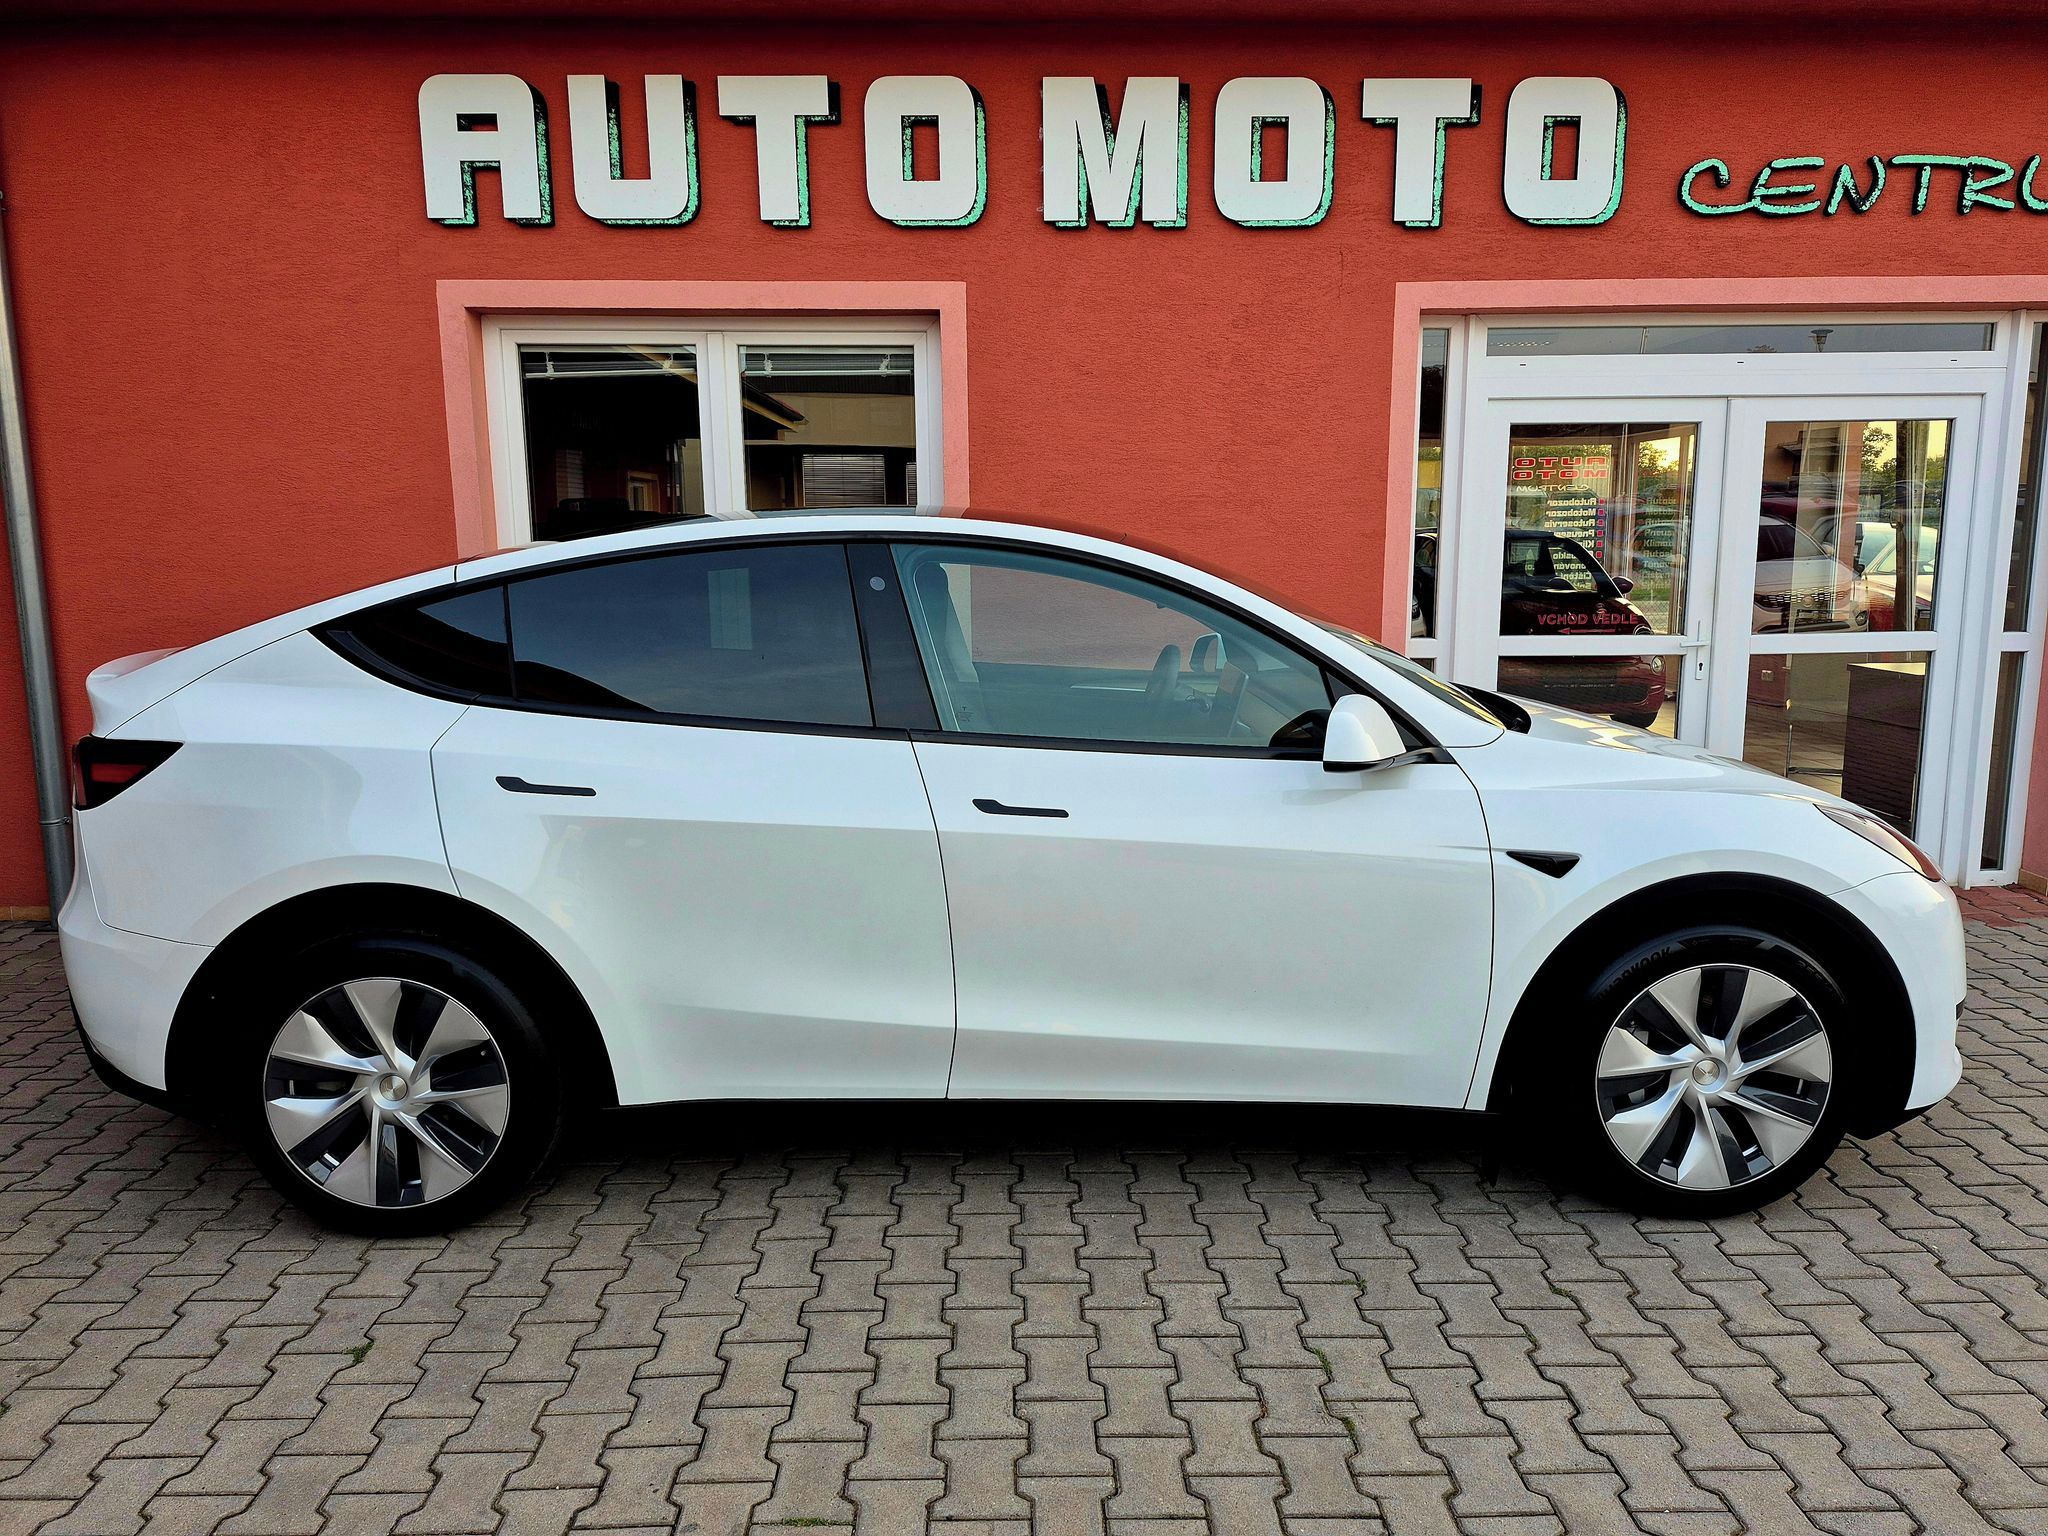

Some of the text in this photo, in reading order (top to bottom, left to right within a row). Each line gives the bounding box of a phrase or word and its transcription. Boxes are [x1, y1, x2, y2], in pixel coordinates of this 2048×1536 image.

[418, 74, 987, 227] AUTO
[1042, 76, 1628, 229] MOTO
[1538, 613, 1639, 625] VCHOD VEDLE
